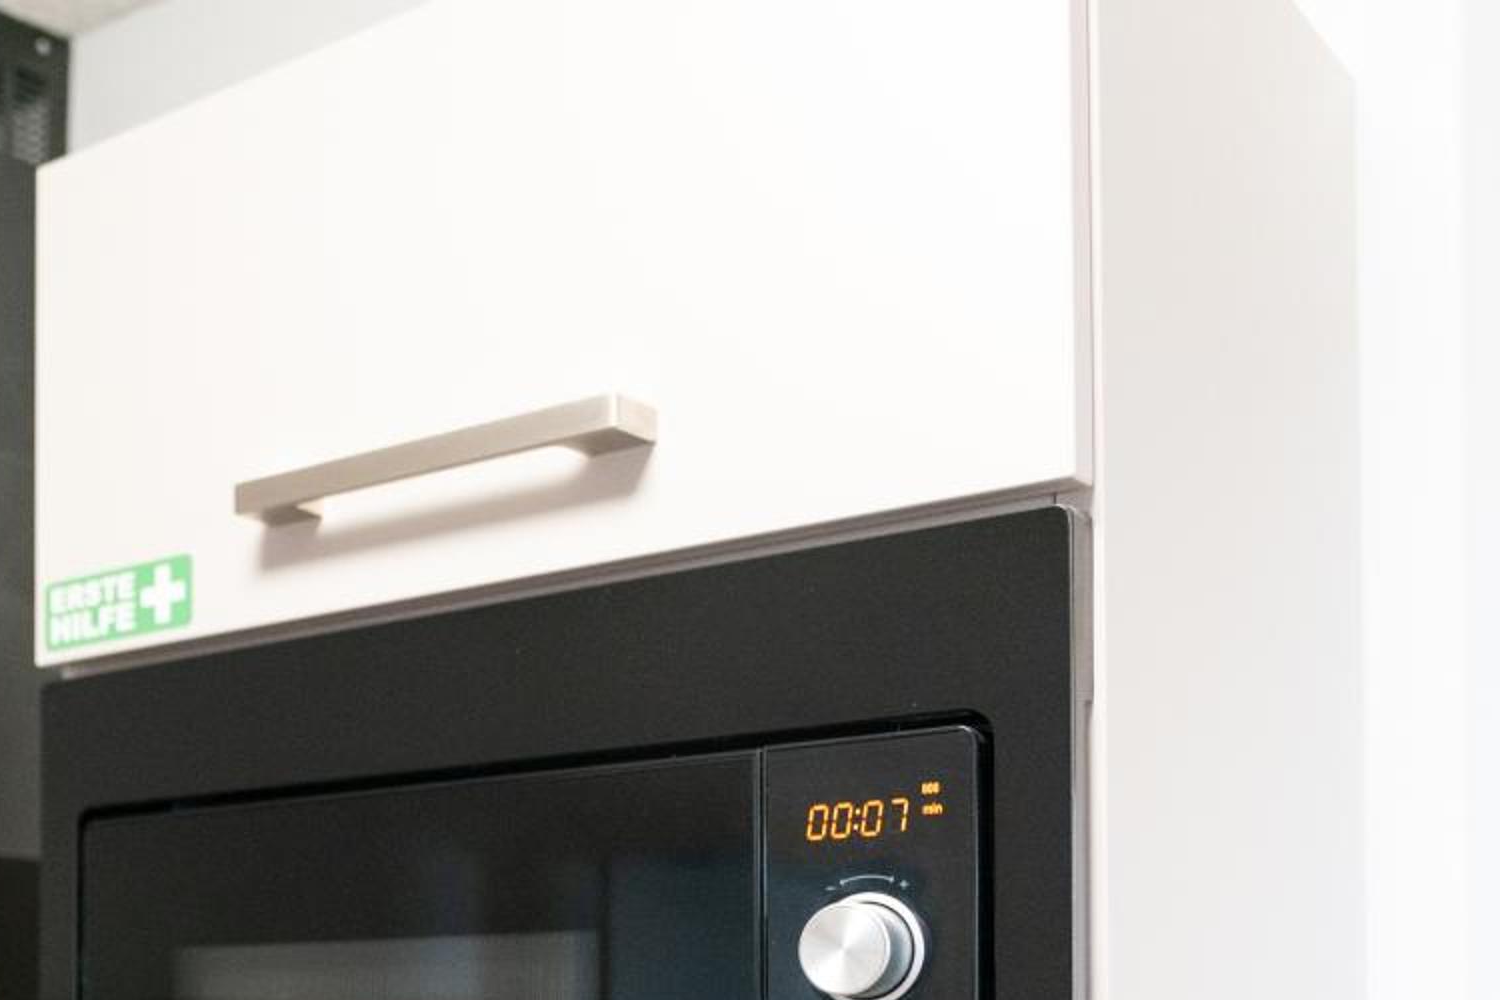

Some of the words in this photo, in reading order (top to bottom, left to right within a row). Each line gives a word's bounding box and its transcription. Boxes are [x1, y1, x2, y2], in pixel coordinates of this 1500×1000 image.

[50, 570, 135, 612] ERSTE
[51, 604, 135, 646] HILFE
[806, 797, 909, 841] 00:07
